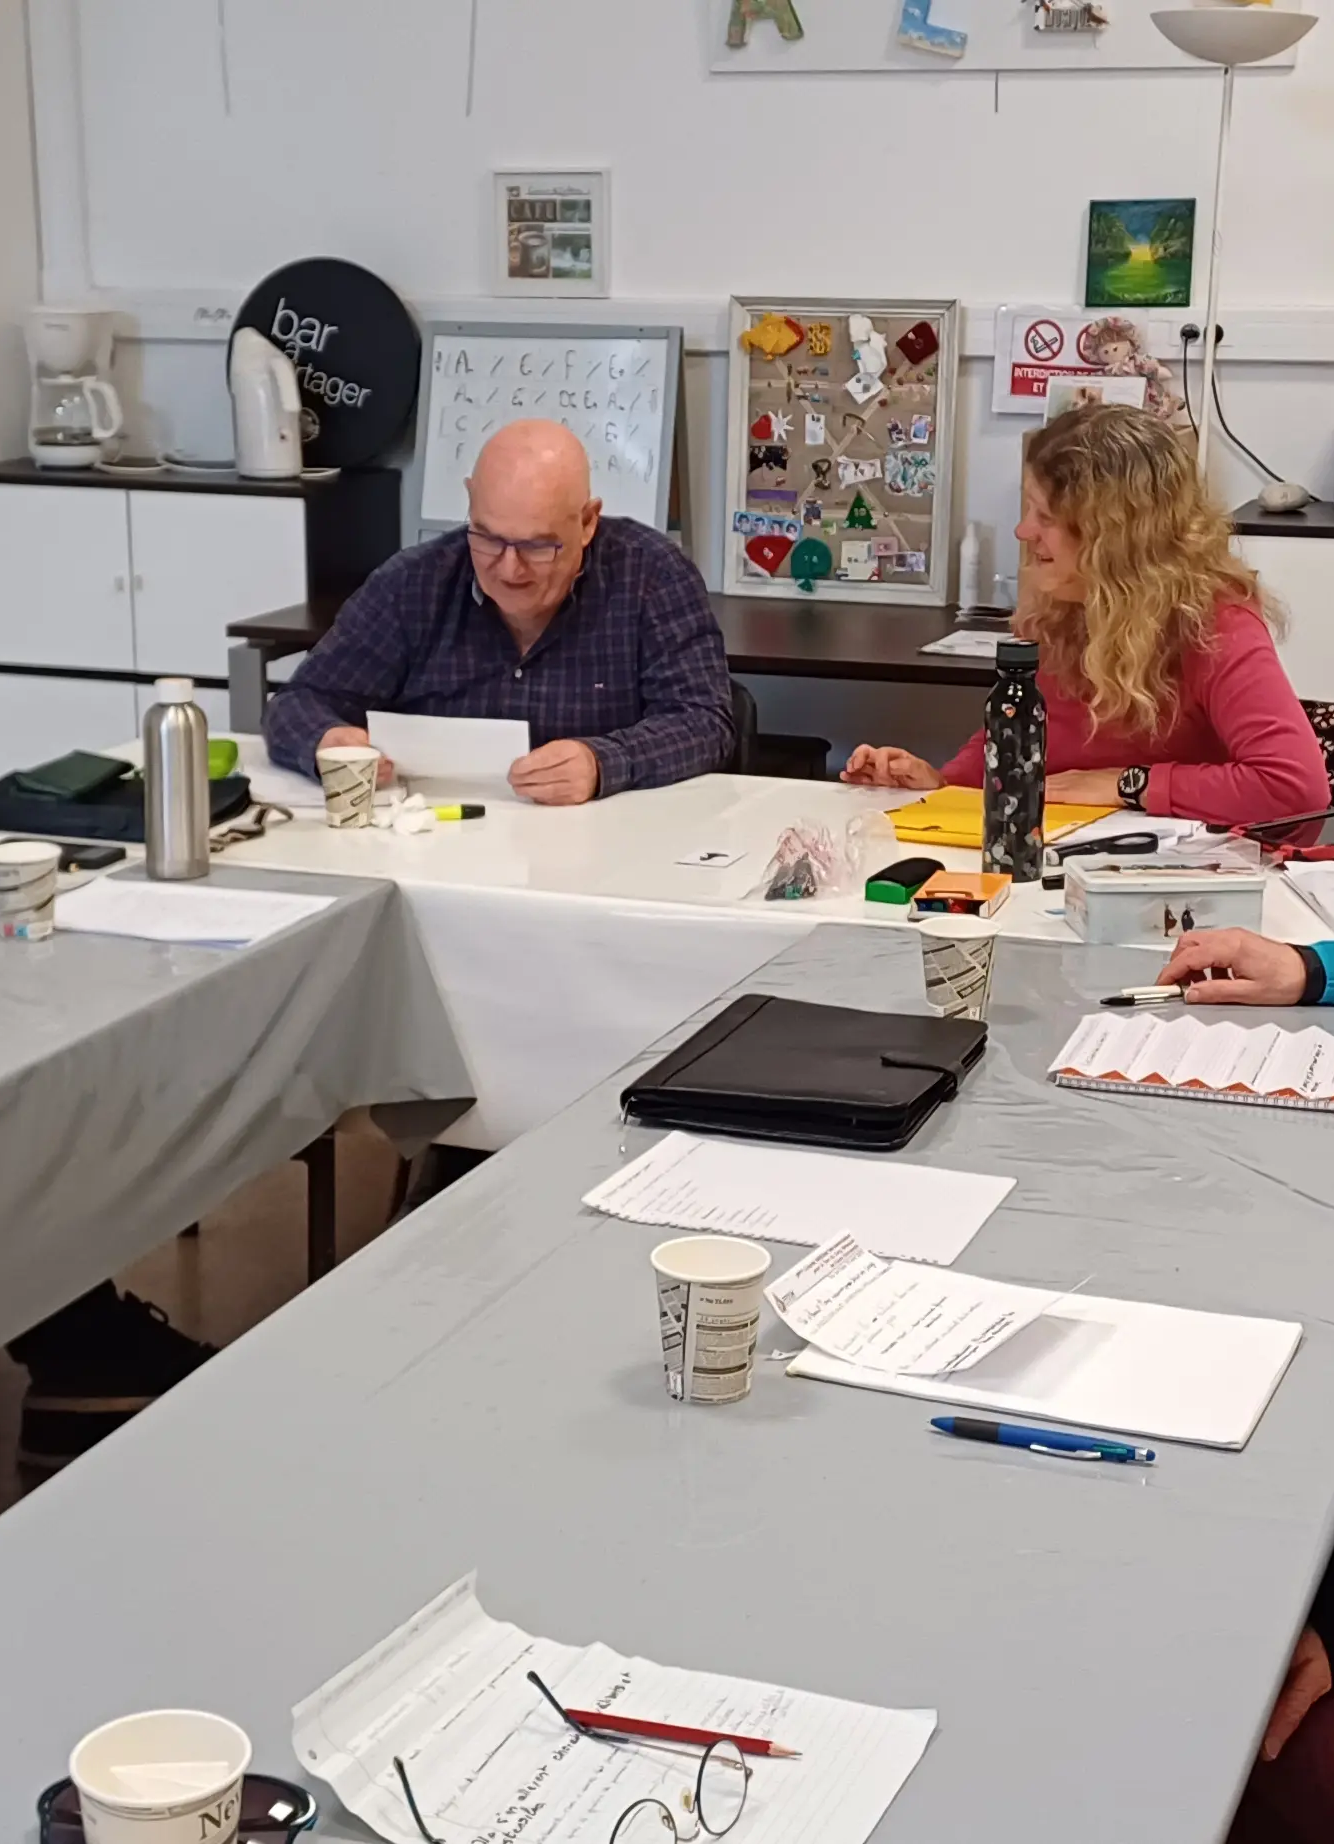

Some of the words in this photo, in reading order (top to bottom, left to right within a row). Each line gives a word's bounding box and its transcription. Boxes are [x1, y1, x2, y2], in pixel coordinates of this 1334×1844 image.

[271, 297, 339, 352] bar
[295, 363, 372, 408] rtager
[1032, 382, 1045, 393] ET
